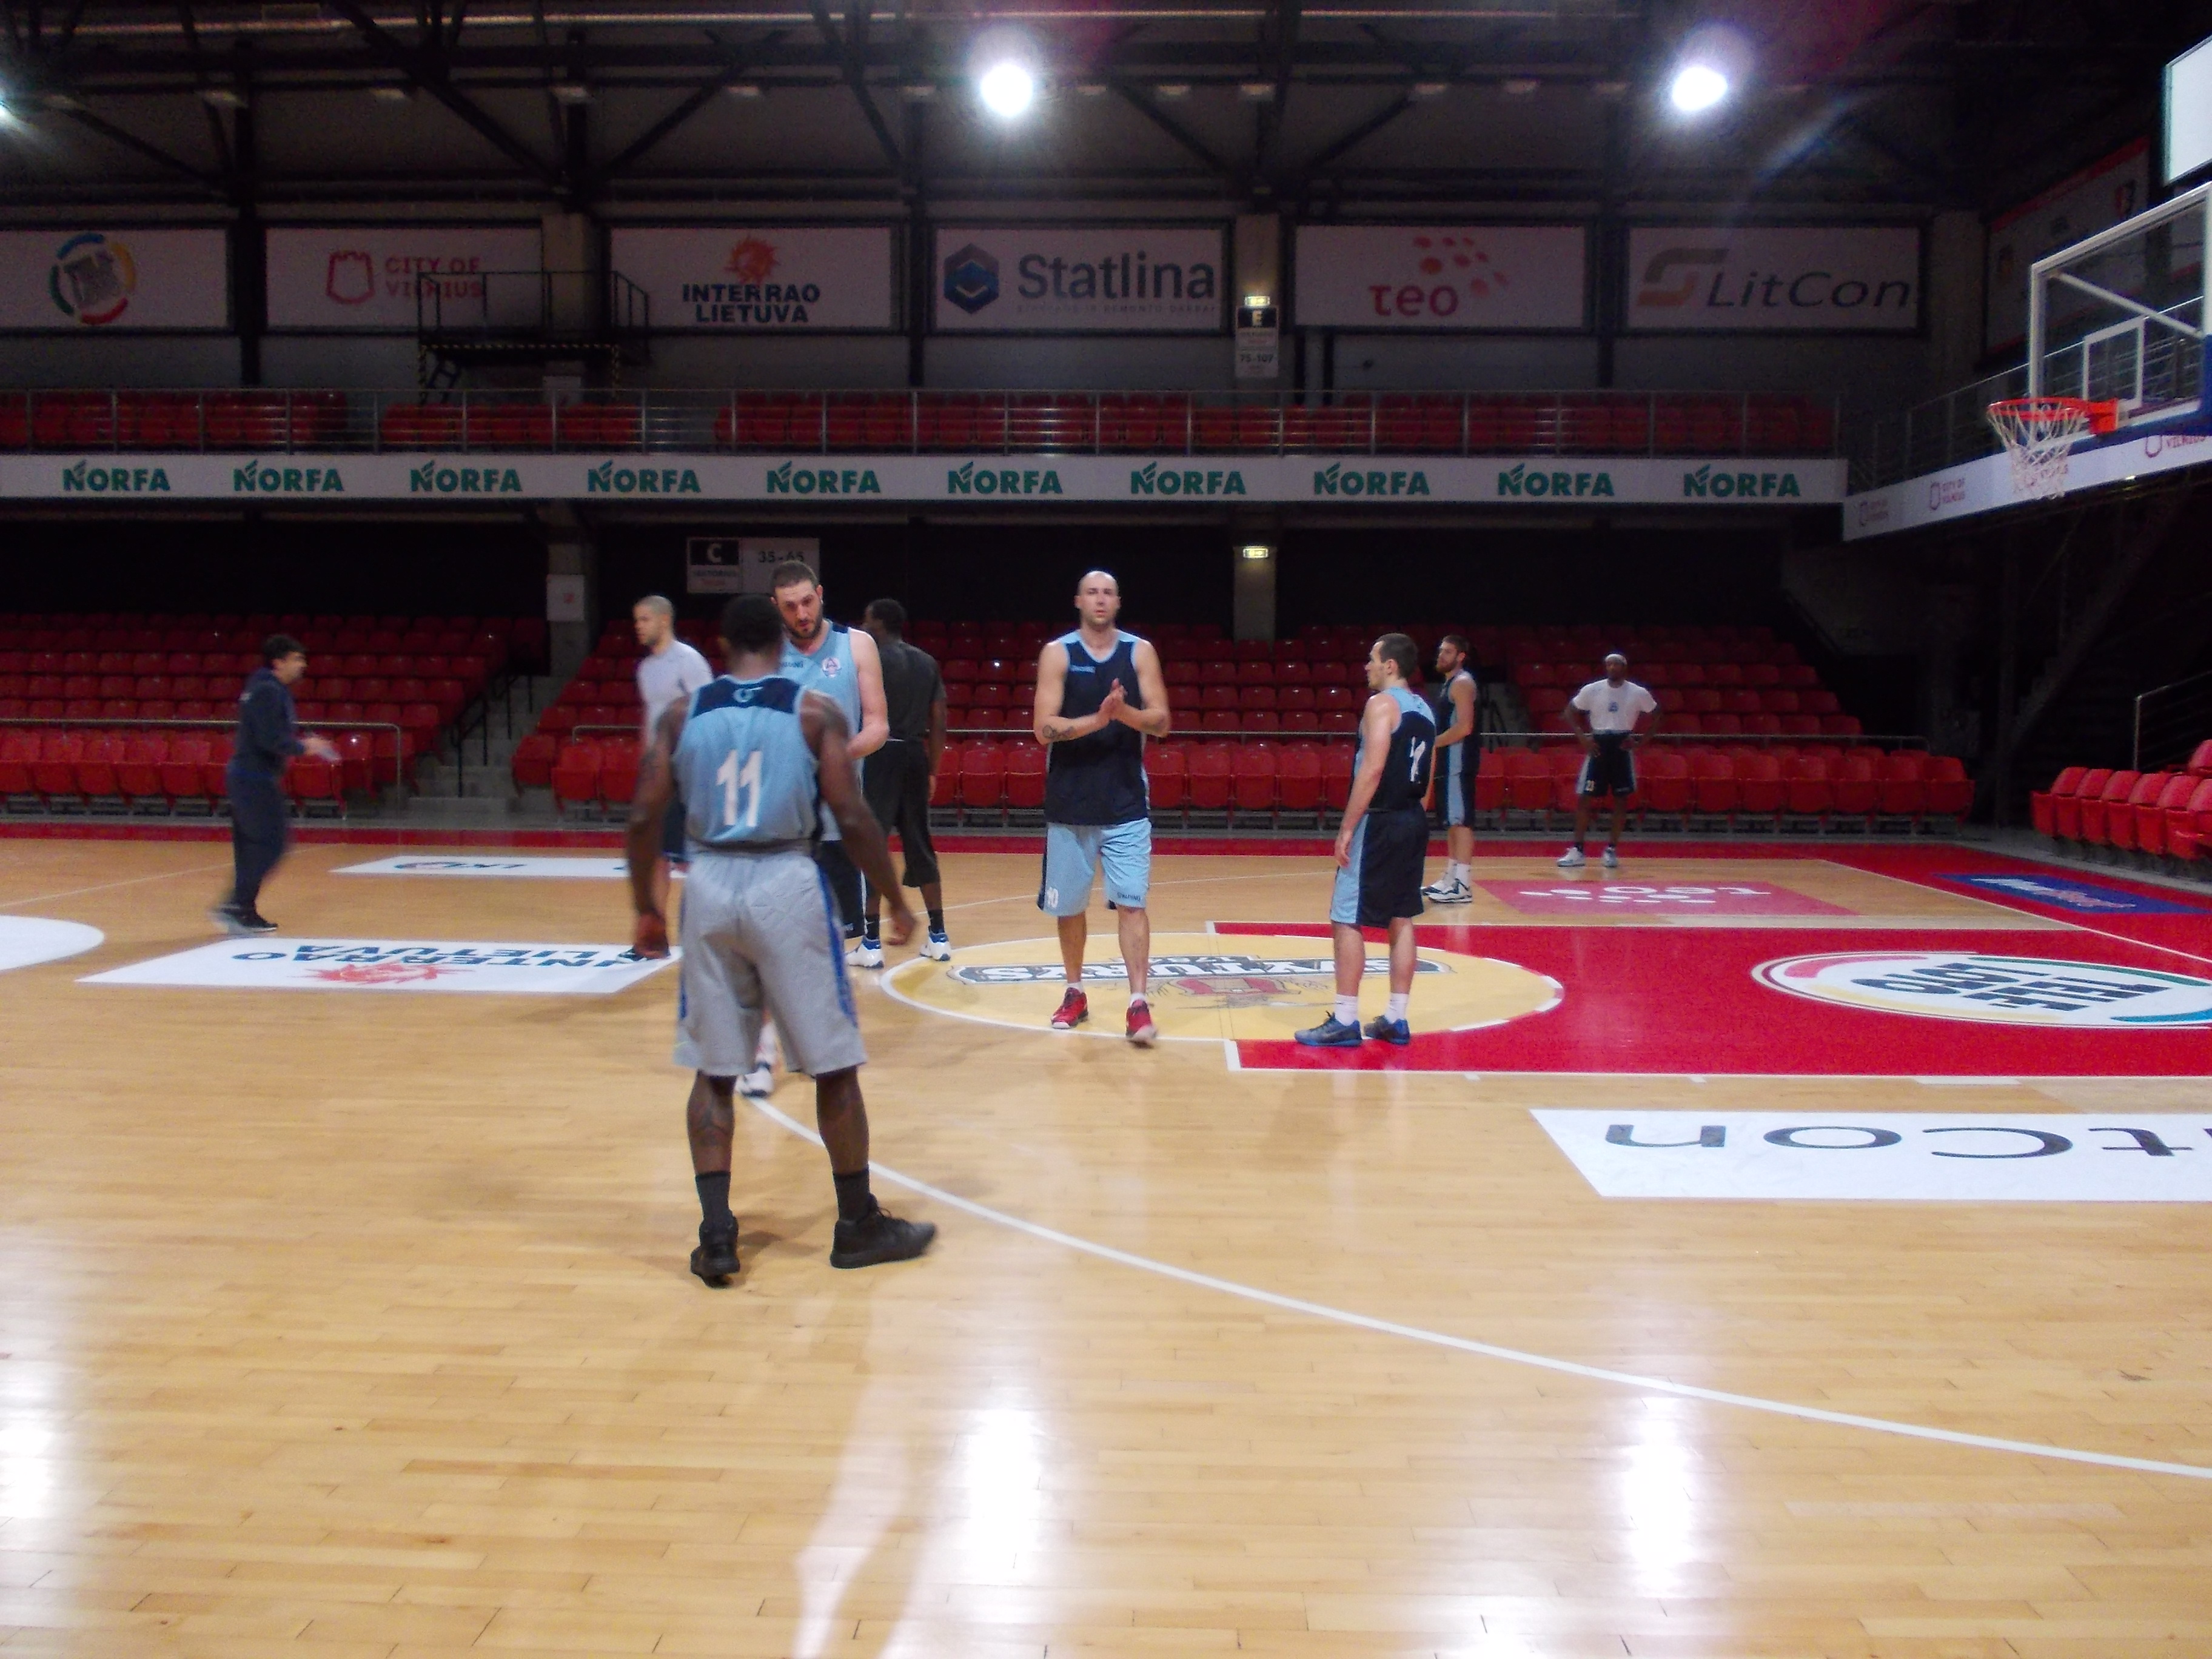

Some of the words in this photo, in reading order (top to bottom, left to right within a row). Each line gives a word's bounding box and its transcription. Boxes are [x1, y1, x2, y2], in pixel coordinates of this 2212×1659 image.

[385, 257, 440, 273] CITY
[449, 257, 480, 273] OF
[1018, 250, 1215, 299] Statlina
[385, 280, 484, 298] VINIUS
[1369, 285, 1460, 316] teo
[1707, 271, 1910, 307] LitCon
[696, 304, 809, 323] LIETUVA
[1252, 310, 1263, 326] E
[61, 461, 170, 492] NORFA
[232, 461, 343, 492] NORFA
[409, 461, 521, 492] NORFA
[588, 461, 700, 492] NORFA
[766, 461, 880, 494] NORFA
[948, 462, 1062, 494] NORFA
[1130, 462, 1246, 495] NORFA
[1313, 463, 1430, 495] NORFA
[1498, 464, 1614, 497] NORFA
[1683, 464, 1800, 497] NORFA
[707, 543, 722, 563] C
[716, 749, 763, 826] 11
[297, 945, 599, 959] LIETUVA
[1851, 963, 2051, 995] LOTO
[1606, 1124, 2212, 1159] tCon
